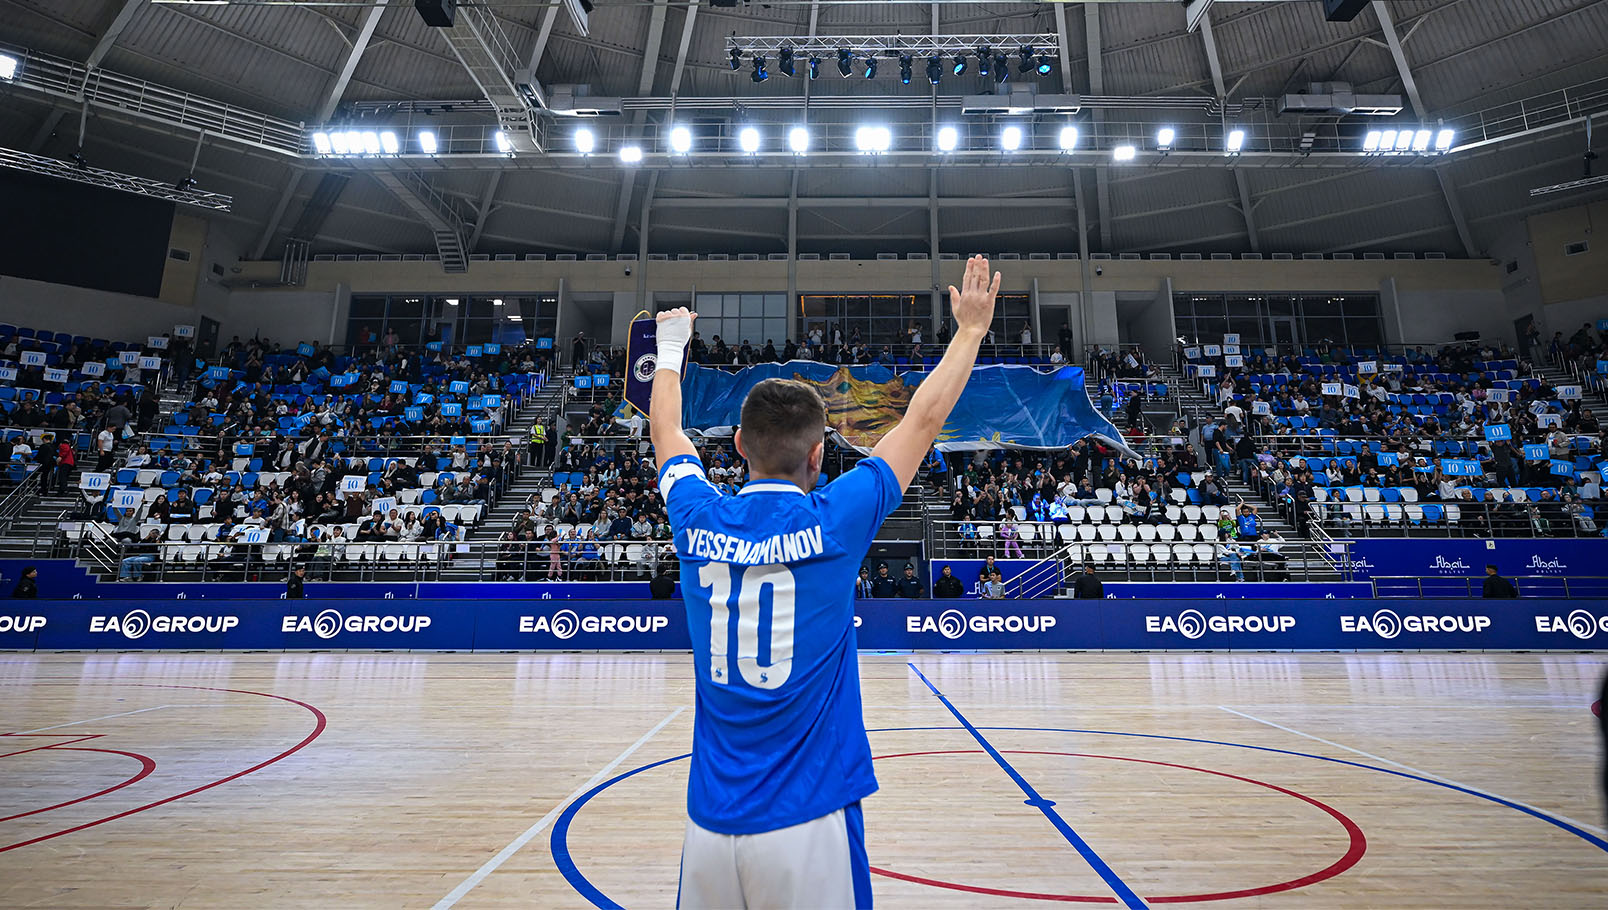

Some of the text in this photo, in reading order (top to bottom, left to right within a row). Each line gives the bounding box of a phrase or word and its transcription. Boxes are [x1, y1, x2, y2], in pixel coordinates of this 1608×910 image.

[447, 405, 455, 413] 10
[1532, 449, 1542, 458] 10
[1448, 464, 1458, 473] 10
[1465, 464, 1475, 473] 10
[89, 478, 101, 487] 10
[348, 480, 358, 489] 10
[122, 496, 134, 505] 10
[379, 502, 389, 512] 10
[248, 532, 260, 542] 10
[686, 525, 824, 564] YESSENAMANOV
[90, 616, 238, 632] EA GROUP
[282, 616, 431, 632] EA GROUP
[520, 616, 668, 632] EA GROUP
[698, 561, 795, 690] 10
[906, 616, 1056, 632] EA GROUP
[1146, 616, 1295, 632] EA GROUP
[1340, 616, 1490, 632] EA GROUP
[1535, 616, 1568, 632] EA
